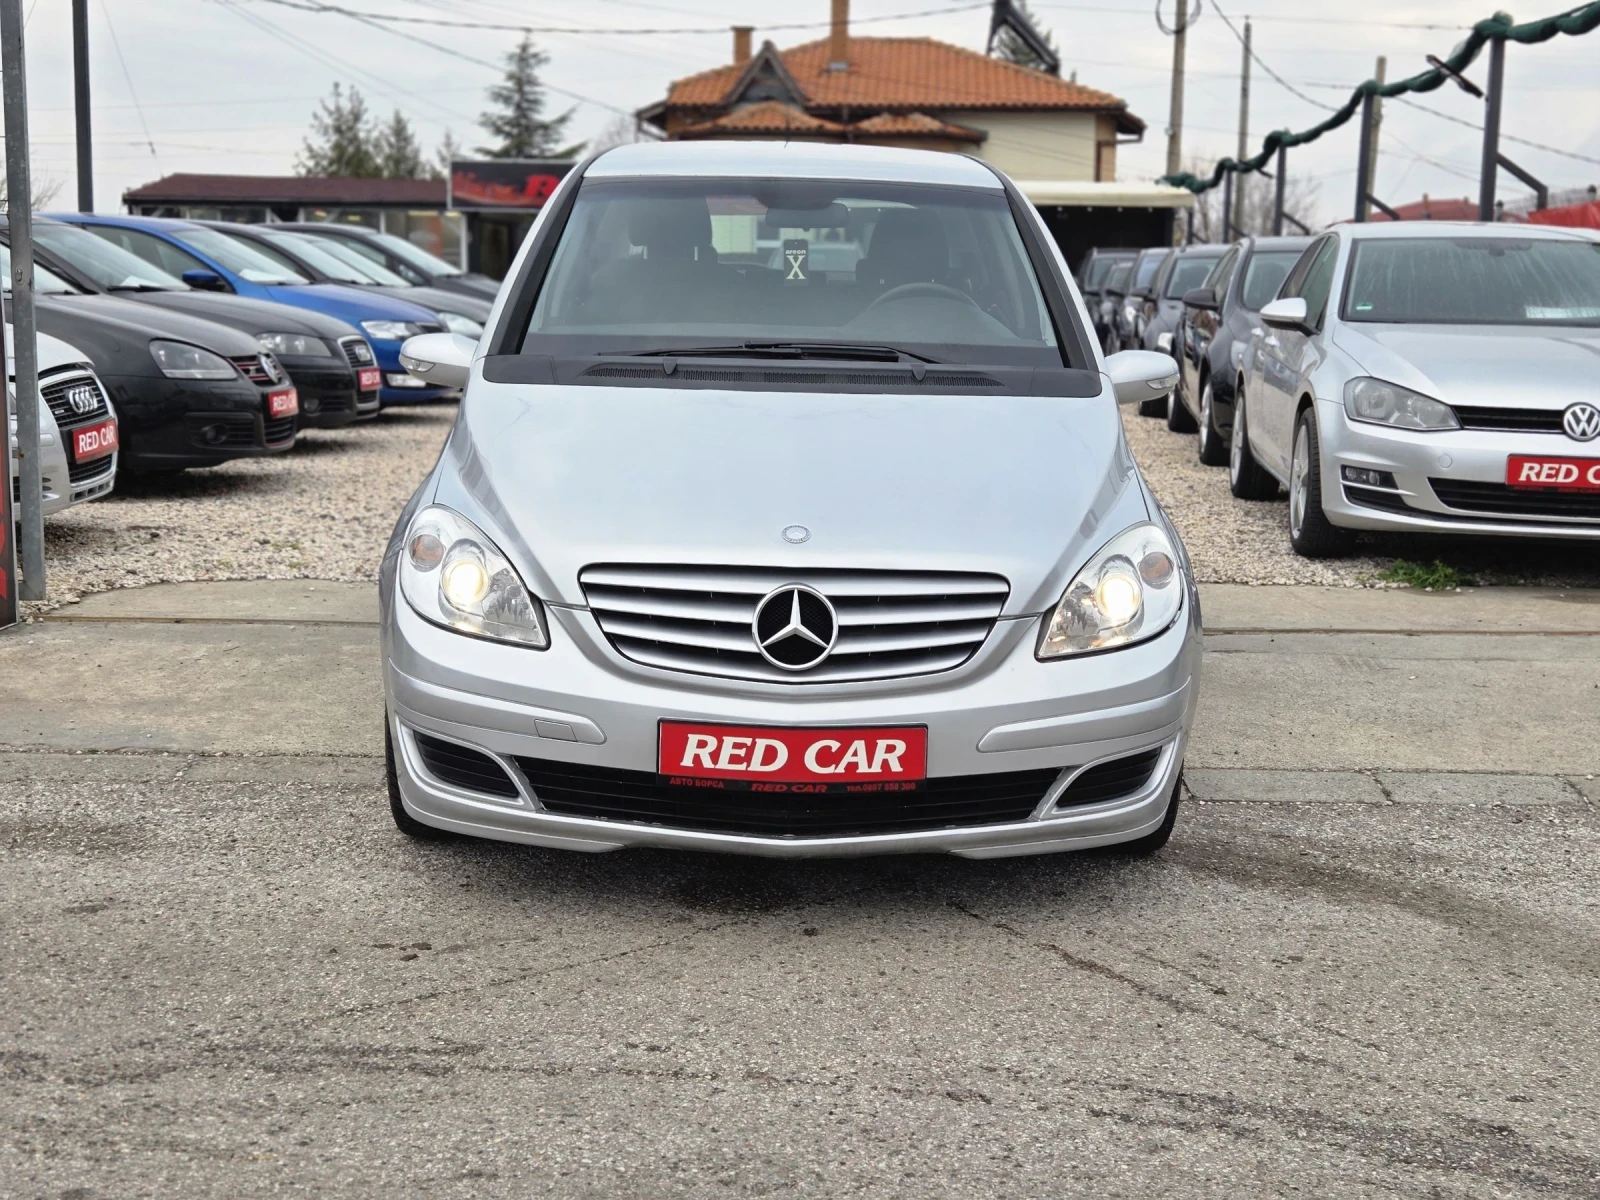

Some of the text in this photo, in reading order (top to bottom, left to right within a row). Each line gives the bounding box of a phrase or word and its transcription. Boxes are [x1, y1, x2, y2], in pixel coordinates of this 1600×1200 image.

[785, 255, 807, 280] X
[78, 430, 100, 453] RED
[1518, 462, 1579, 483] RED
[680, 733, 907, 774] RED CAR
[750, 783, 828, 793] RED CAR
